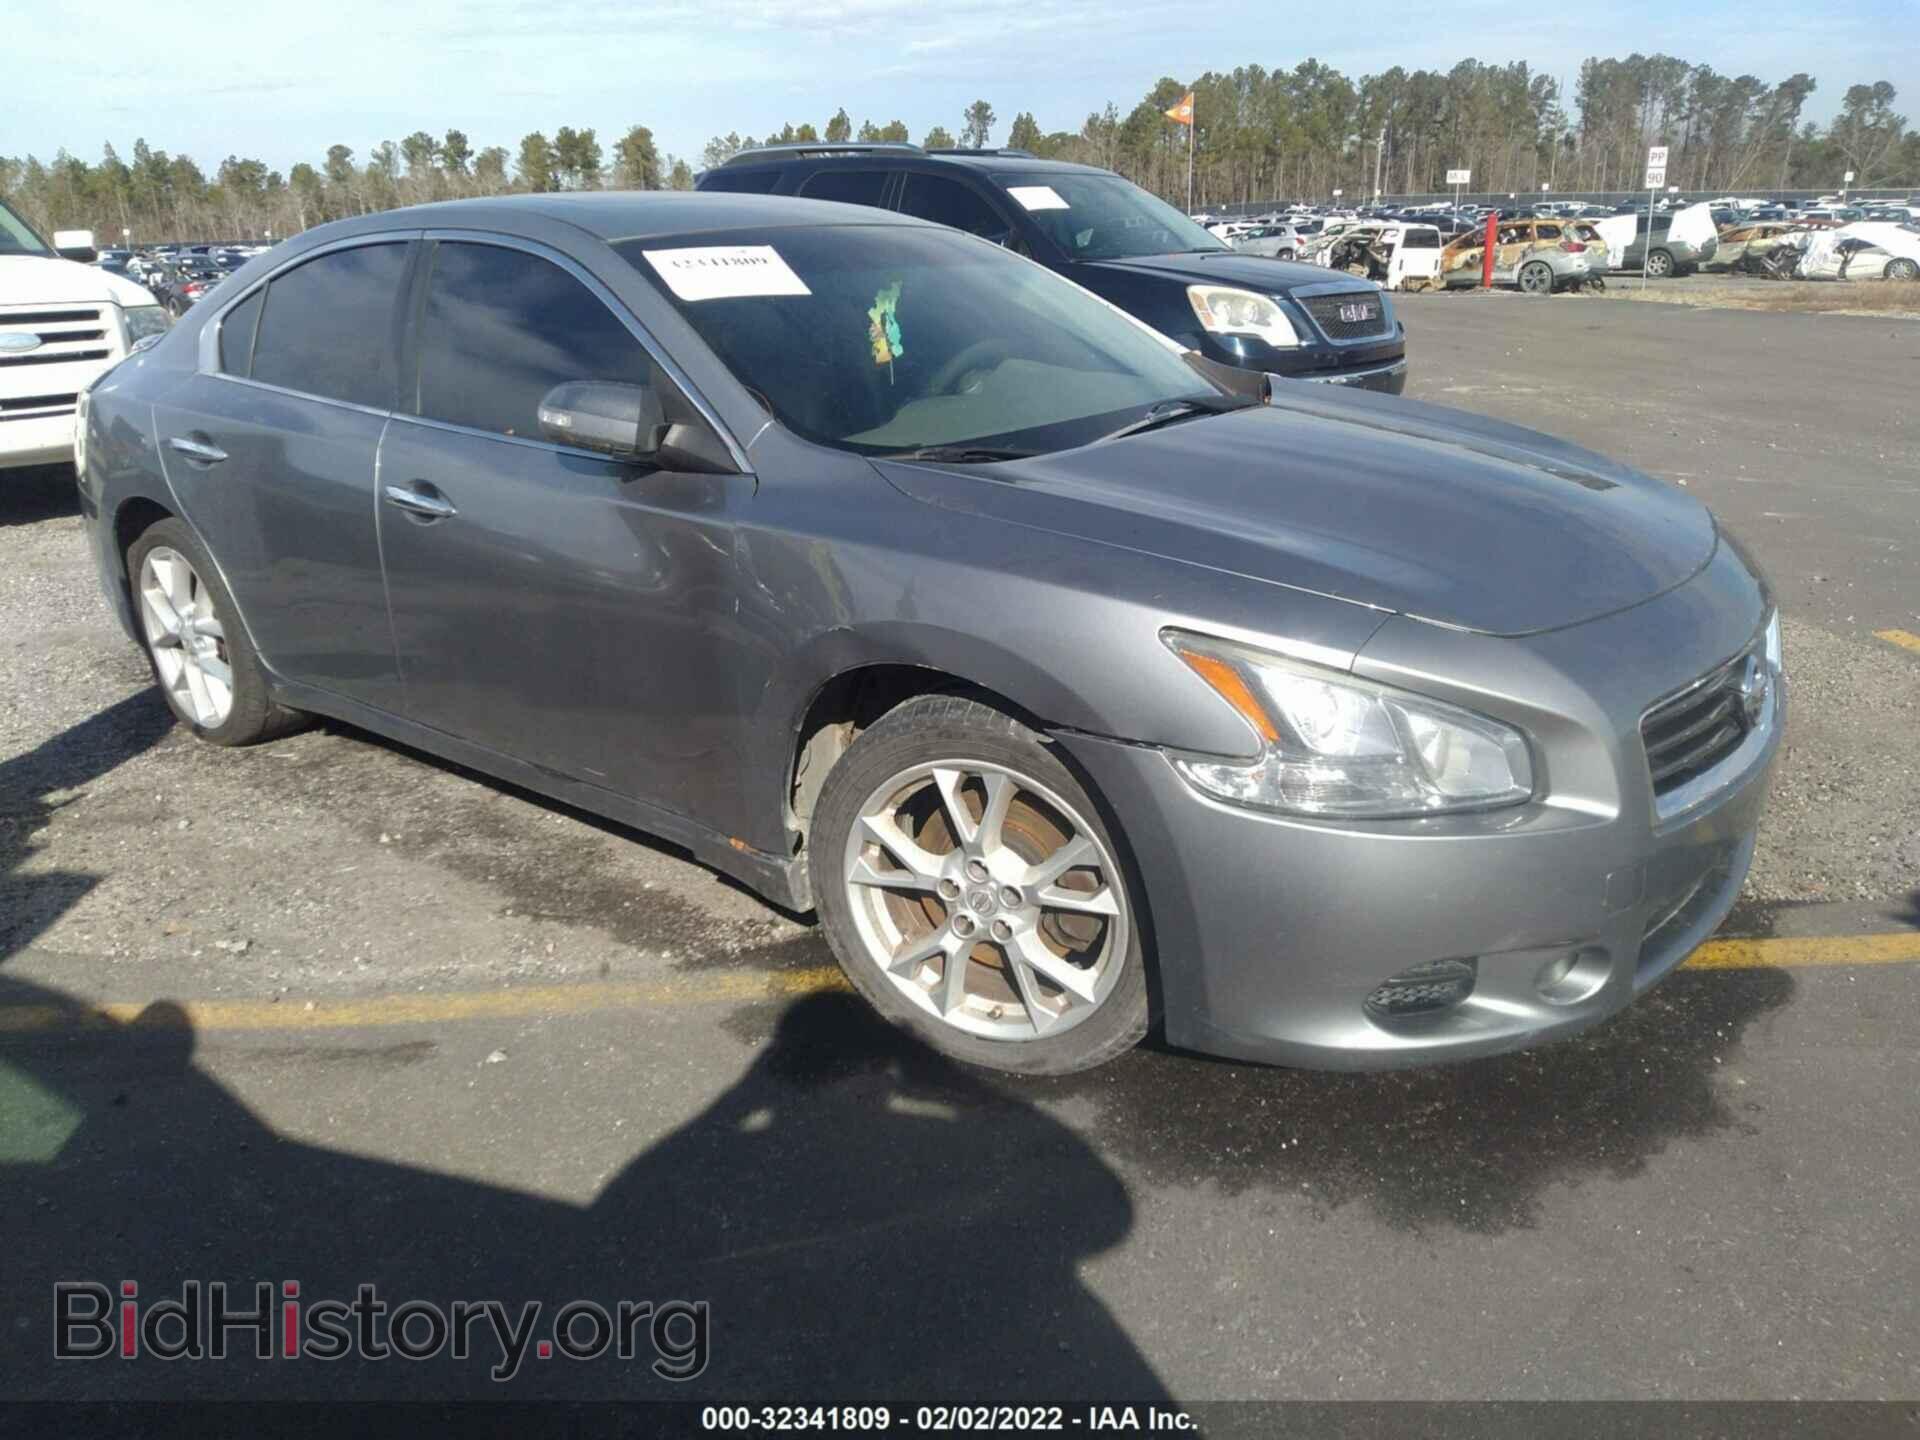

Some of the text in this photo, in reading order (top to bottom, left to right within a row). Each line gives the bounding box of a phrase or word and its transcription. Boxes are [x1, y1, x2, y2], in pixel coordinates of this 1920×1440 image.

[1650, 151, 1665, 163] PP
[1647, 172, 1663, 184] 90
[671, 255, 769, 269] 1809
